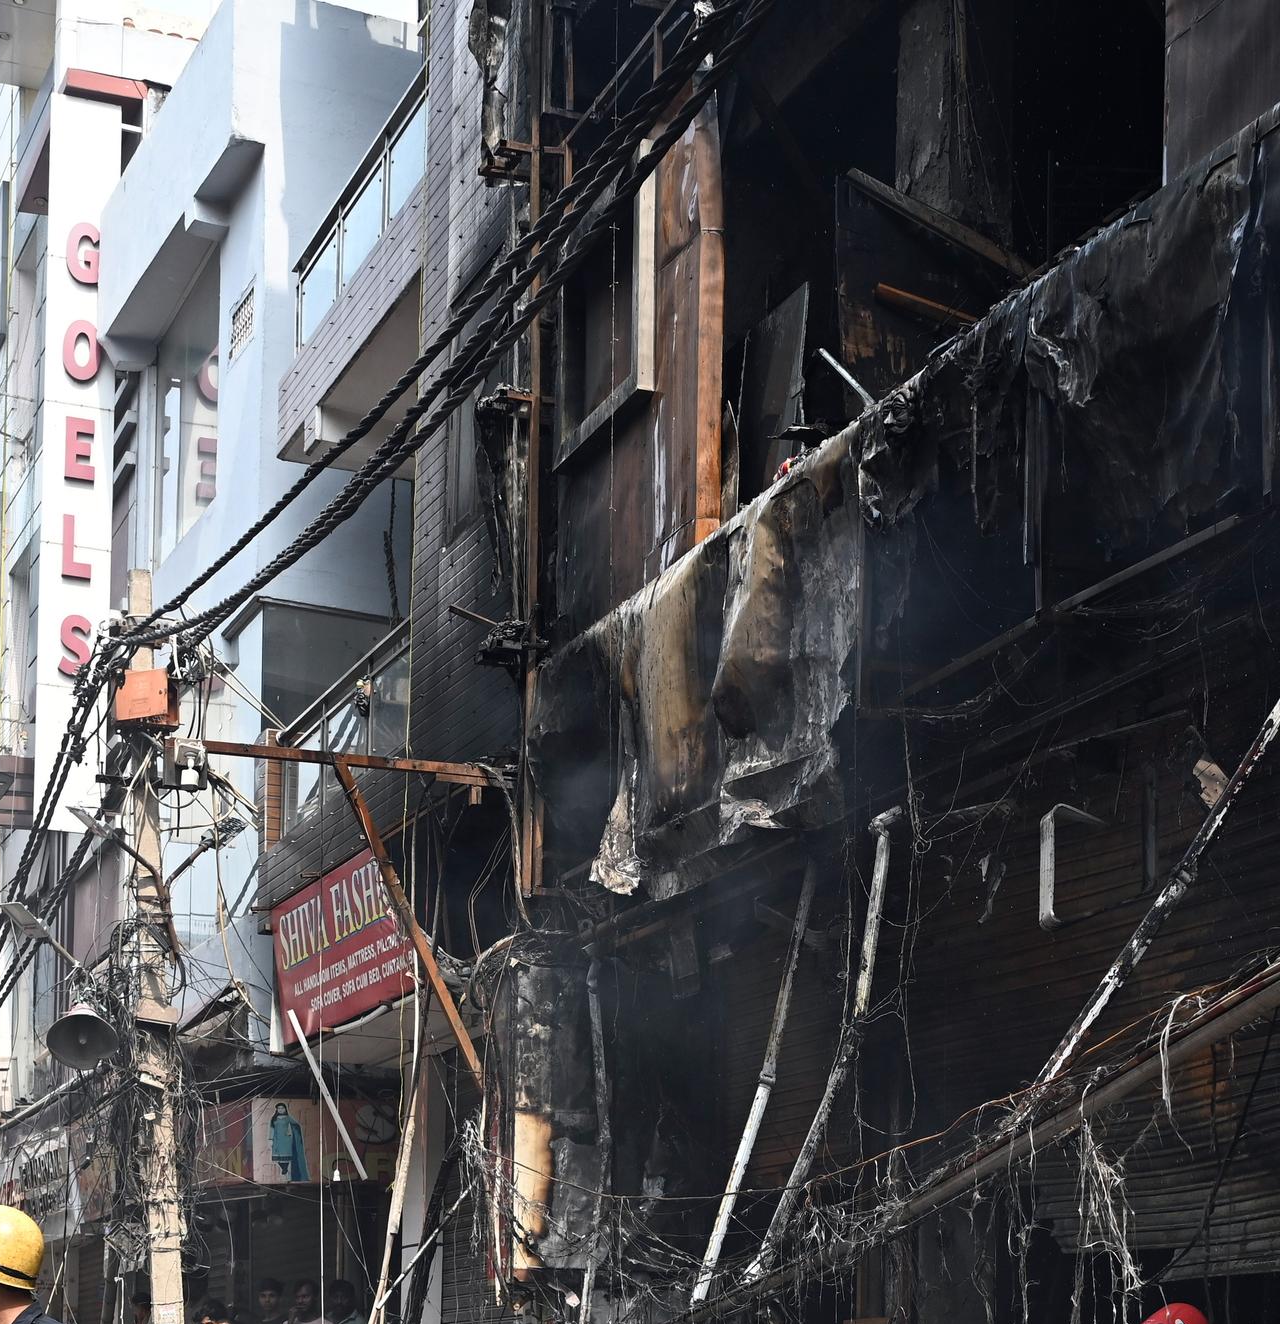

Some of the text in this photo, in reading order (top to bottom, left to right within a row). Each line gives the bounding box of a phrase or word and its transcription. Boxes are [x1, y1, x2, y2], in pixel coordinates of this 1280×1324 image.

[58, 221, 103, 678] GOELS
[279, 895, 330, 970] SHIVA
[294, 981, 303, 996] ALL
[342, 981, 356, 998] SOFA
[355, 974, 369, 991] CUM
